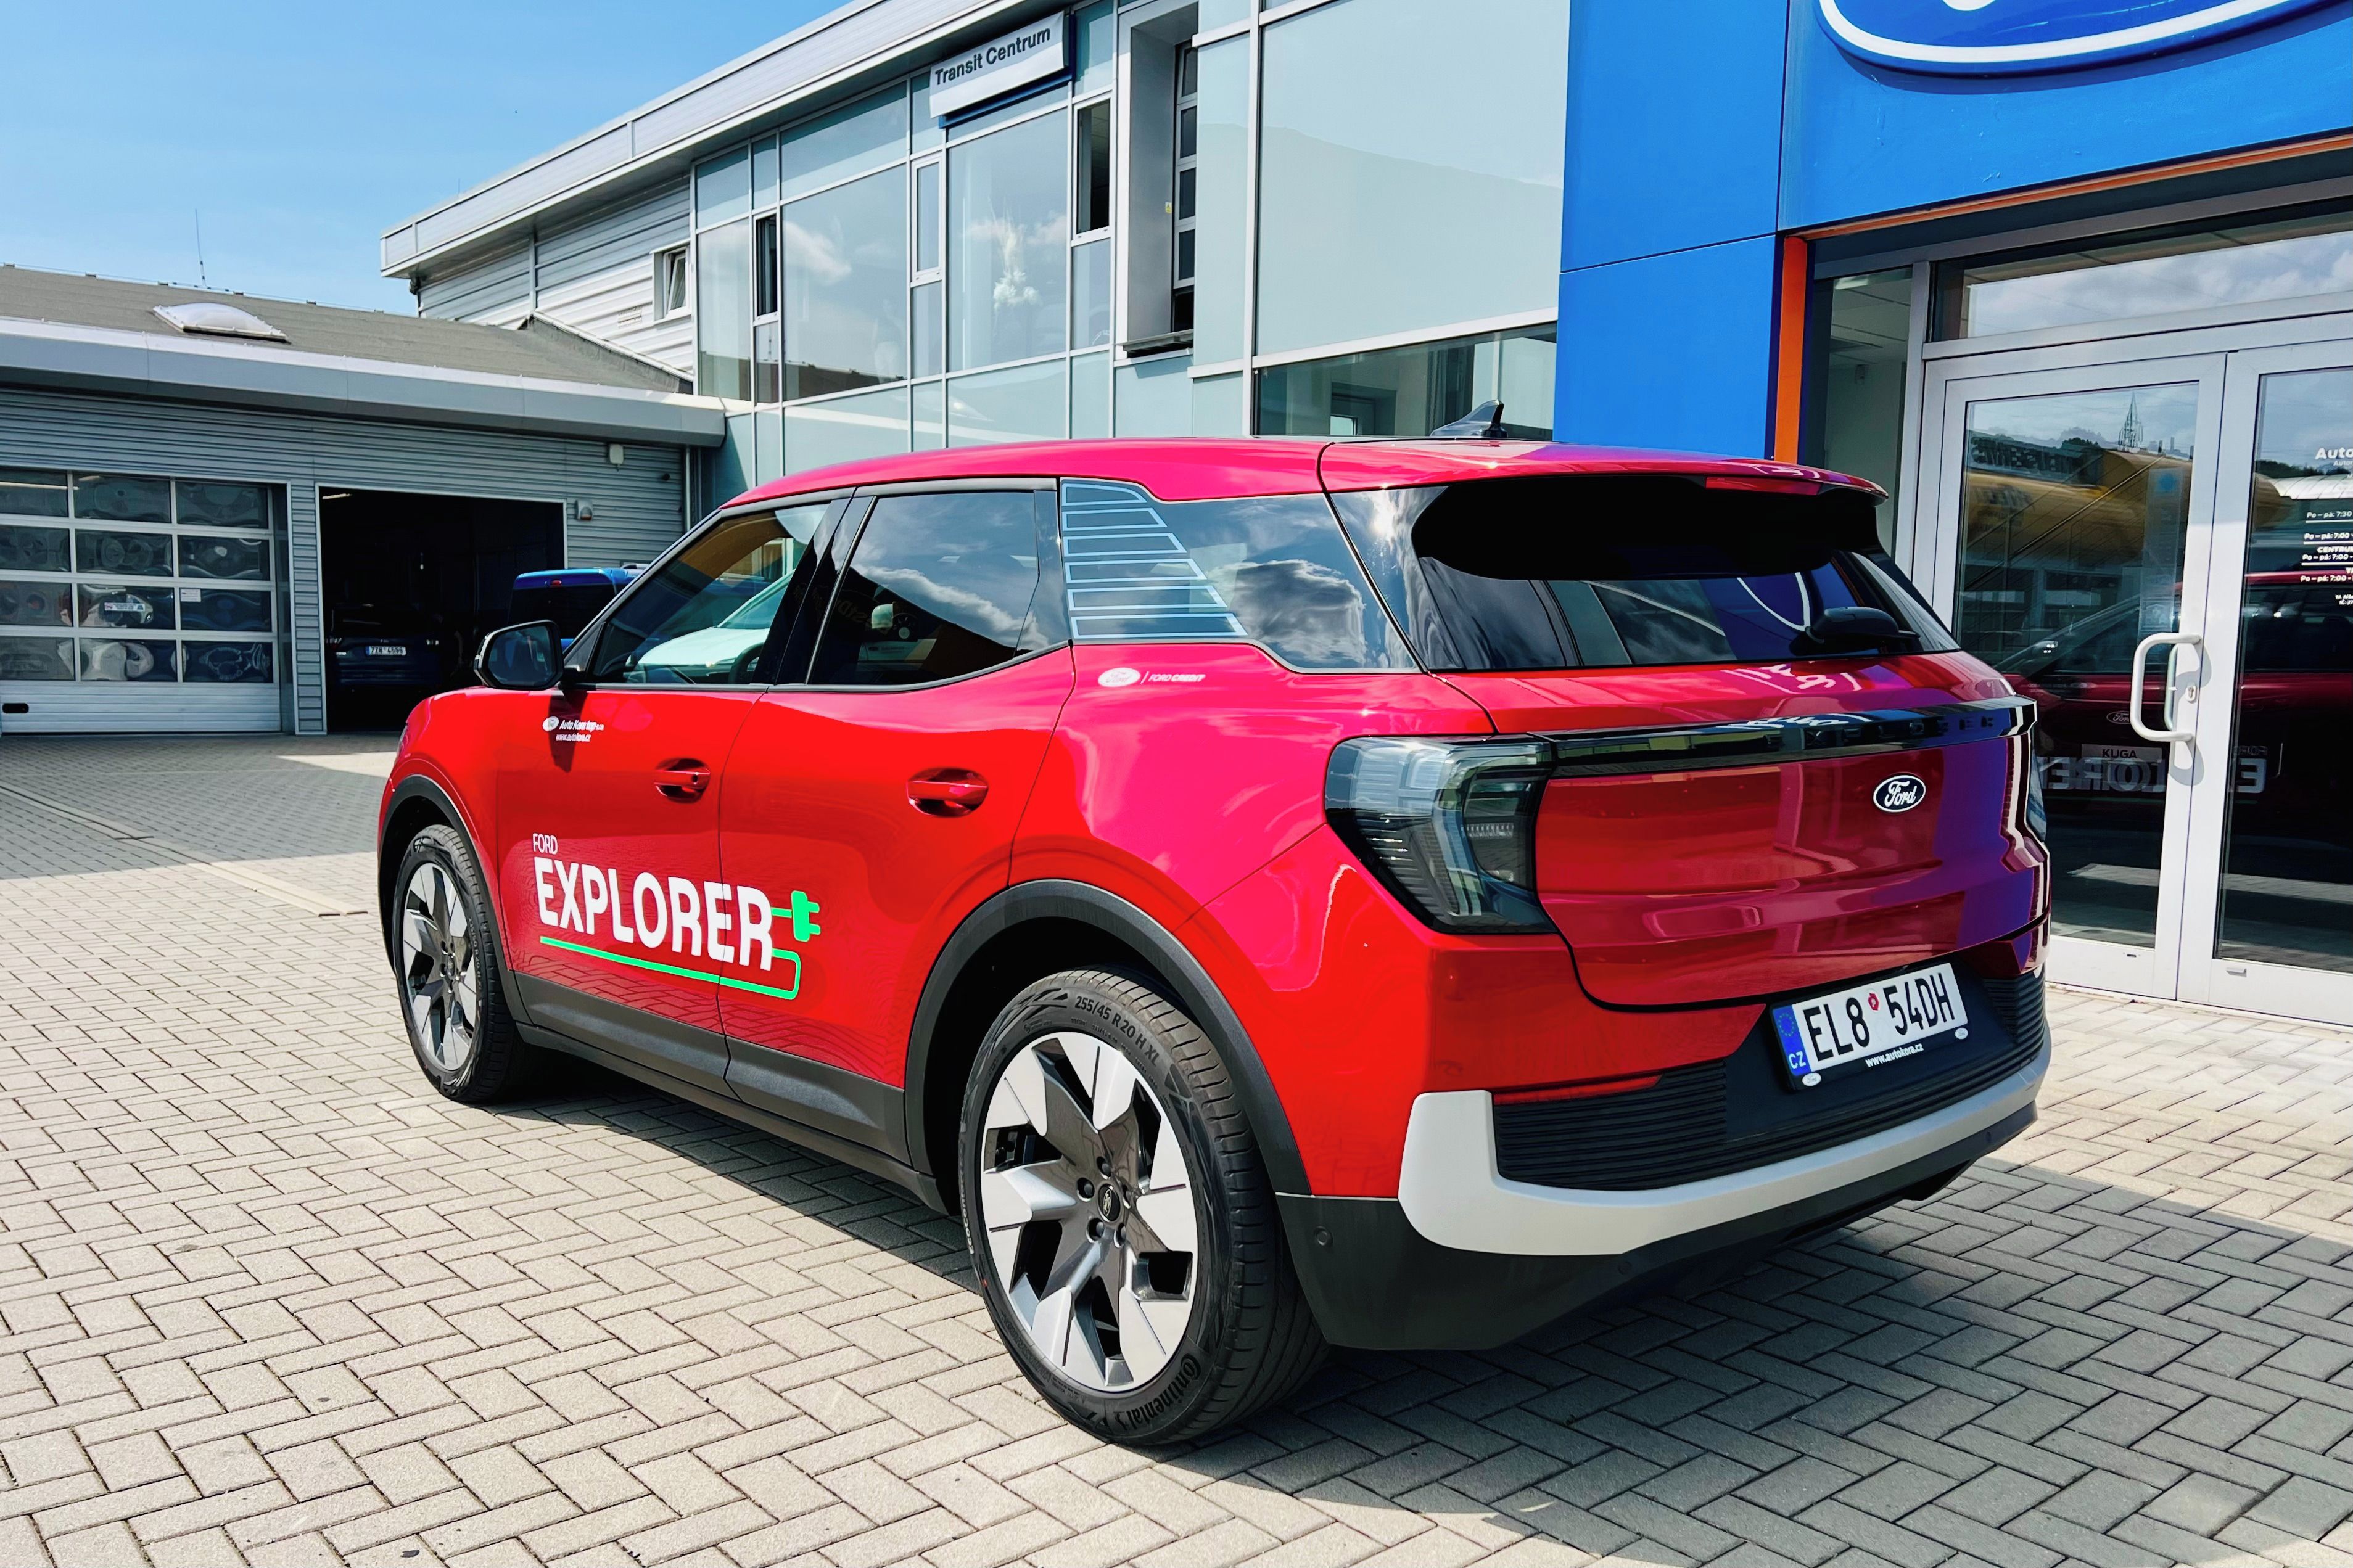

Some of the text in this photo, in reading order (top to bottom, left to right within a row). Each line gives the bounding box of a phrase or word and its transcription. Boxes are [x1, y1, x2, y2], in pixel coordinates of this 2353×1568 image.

[935, 27, 1050, 86] Transit Centrum
[1148, 674, 1172, 682] FORD
[2103, 749, 2137, 758] KUGA
[1884, 781, 1917, 807] Ford
[532, 834, 558, 855] FORD
[534, 856, 773, 971] EXPLORER
[1803, 972, 1955, 1061] EL8 54DH
[1075, 996, 1111, 1020] 255/45
[1135, 1033, 1147, 1049] H
[1144, 1048, 1160, 1067] XL
[1788, 1051, 1806, 1070] CZ
[1865, 1043, 1924, 1068] www.autokora.cz
[1126, 1353, 1202, 1431] Continental
